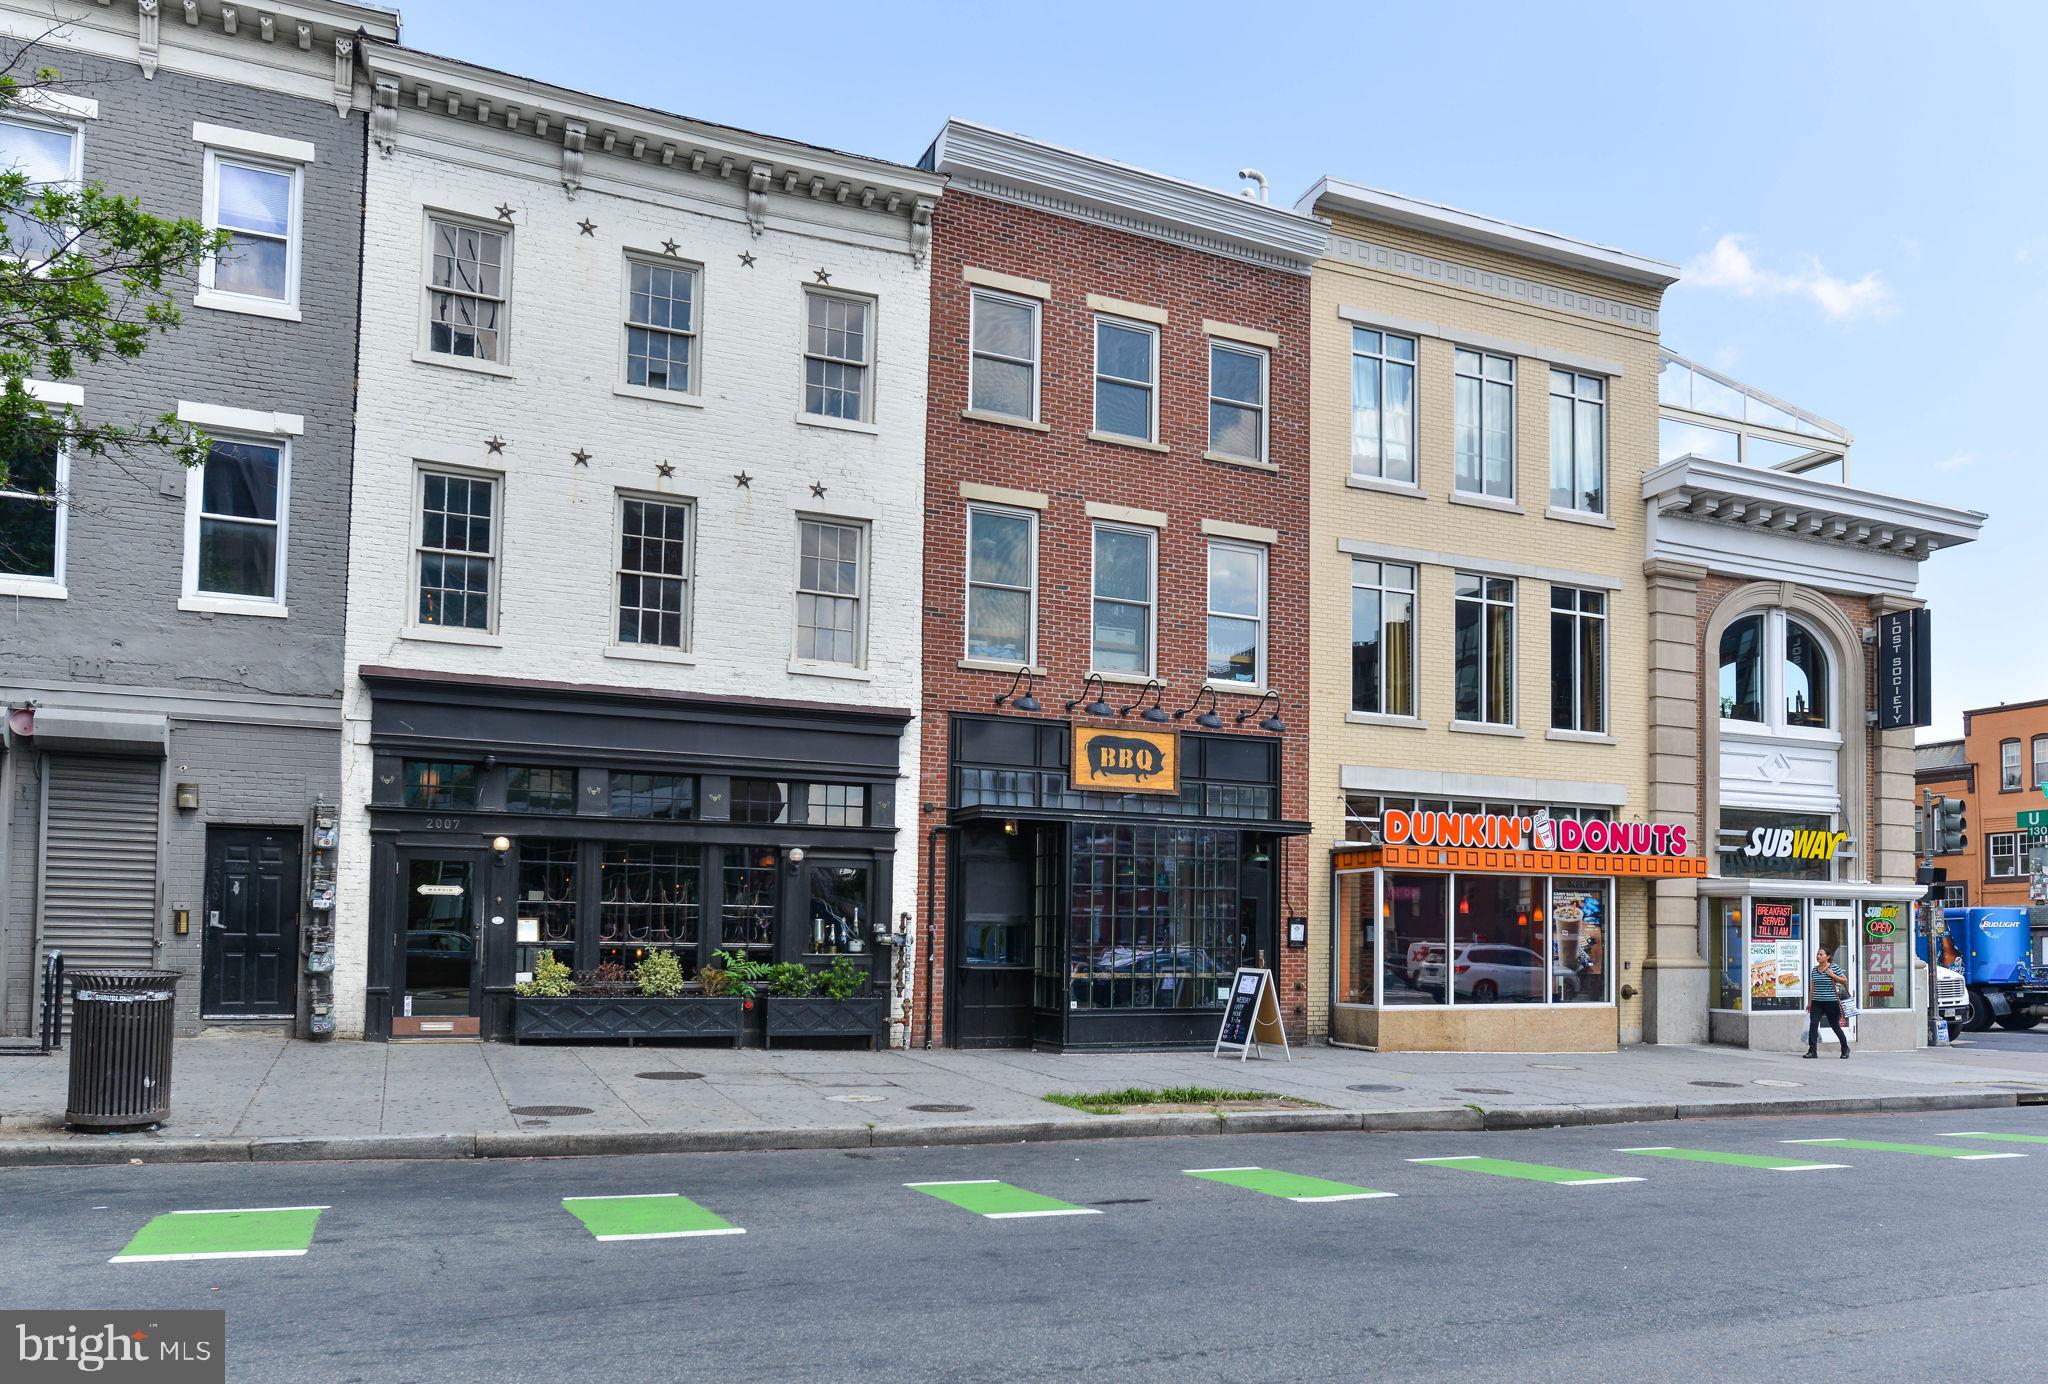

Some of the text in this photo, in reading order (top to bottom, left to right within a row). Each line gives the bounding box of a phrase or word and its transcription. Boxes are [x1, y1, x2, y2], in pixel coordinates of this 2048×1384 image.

[1891, 616, 1902, 724] LOST SOCIETY
[1100, 746, 1153, 771] BBQ
[426, 819, 460, 830] 2007
[2029, 811, 2040, 825] U
[1384, 809, 1688, 856] DUNKIN' DONUTS
[1743, 827, 1848, 860] SUBWAY
[1757, 906, 1791, 916] BREAKFAST
[1865, 906, 1899, 918] SUBWAY
[1762, 916, 1786, 926] SERVED
[1870, 921, 1892, 934] OPEN
[1759, 926, 1771, 935] TILL
[1870, 953, 1893, 972] 24
[1870, 984, 1894, 992] SUBWAY
